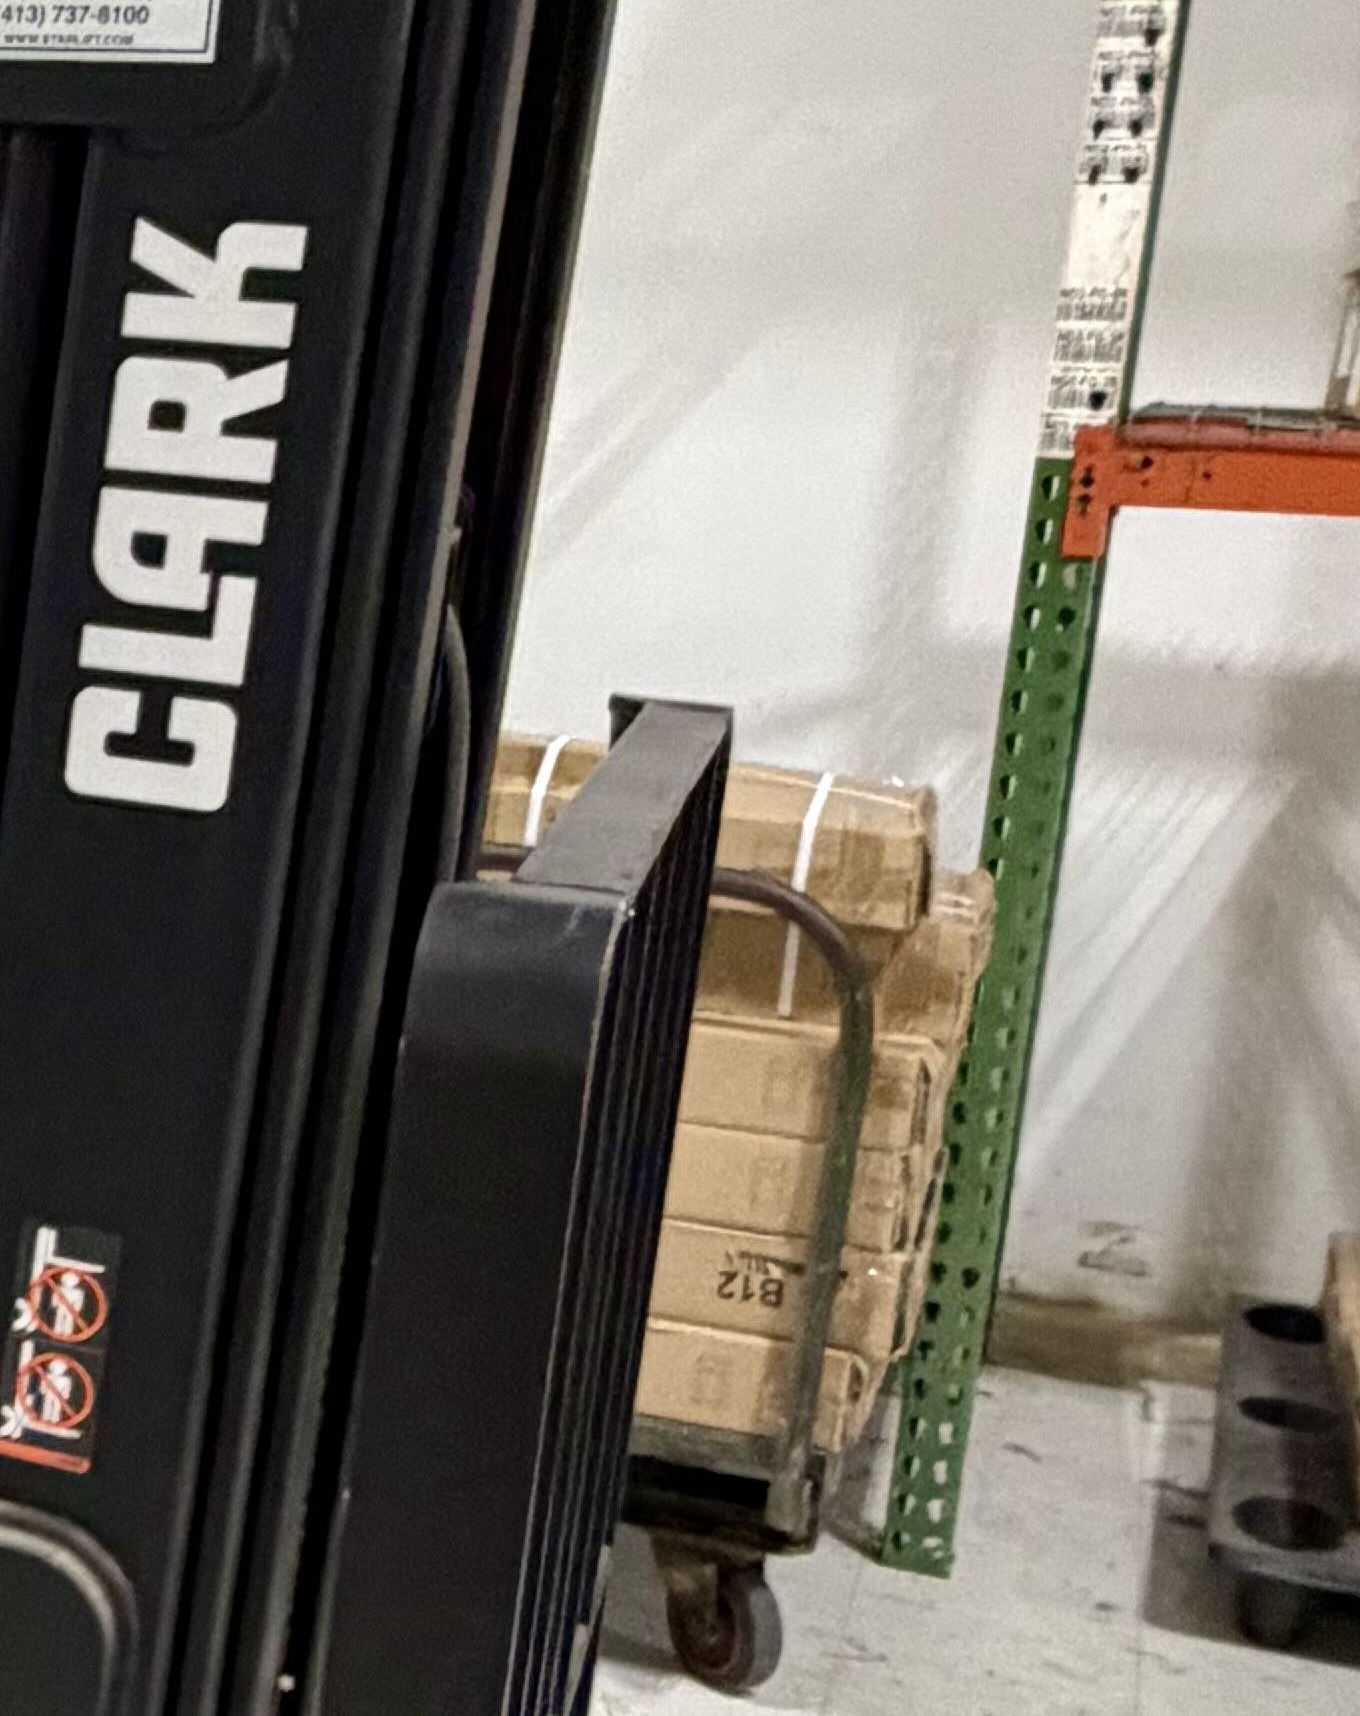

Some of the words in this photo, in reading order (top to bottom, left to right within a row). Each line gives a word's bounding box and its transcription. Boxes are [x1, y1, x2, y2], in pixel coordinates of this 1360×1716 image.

[52, 5, 150, 25] 737-8100
[65, 217, 308, 813] CLARK
[716, 1270, 784, 1308] B12
